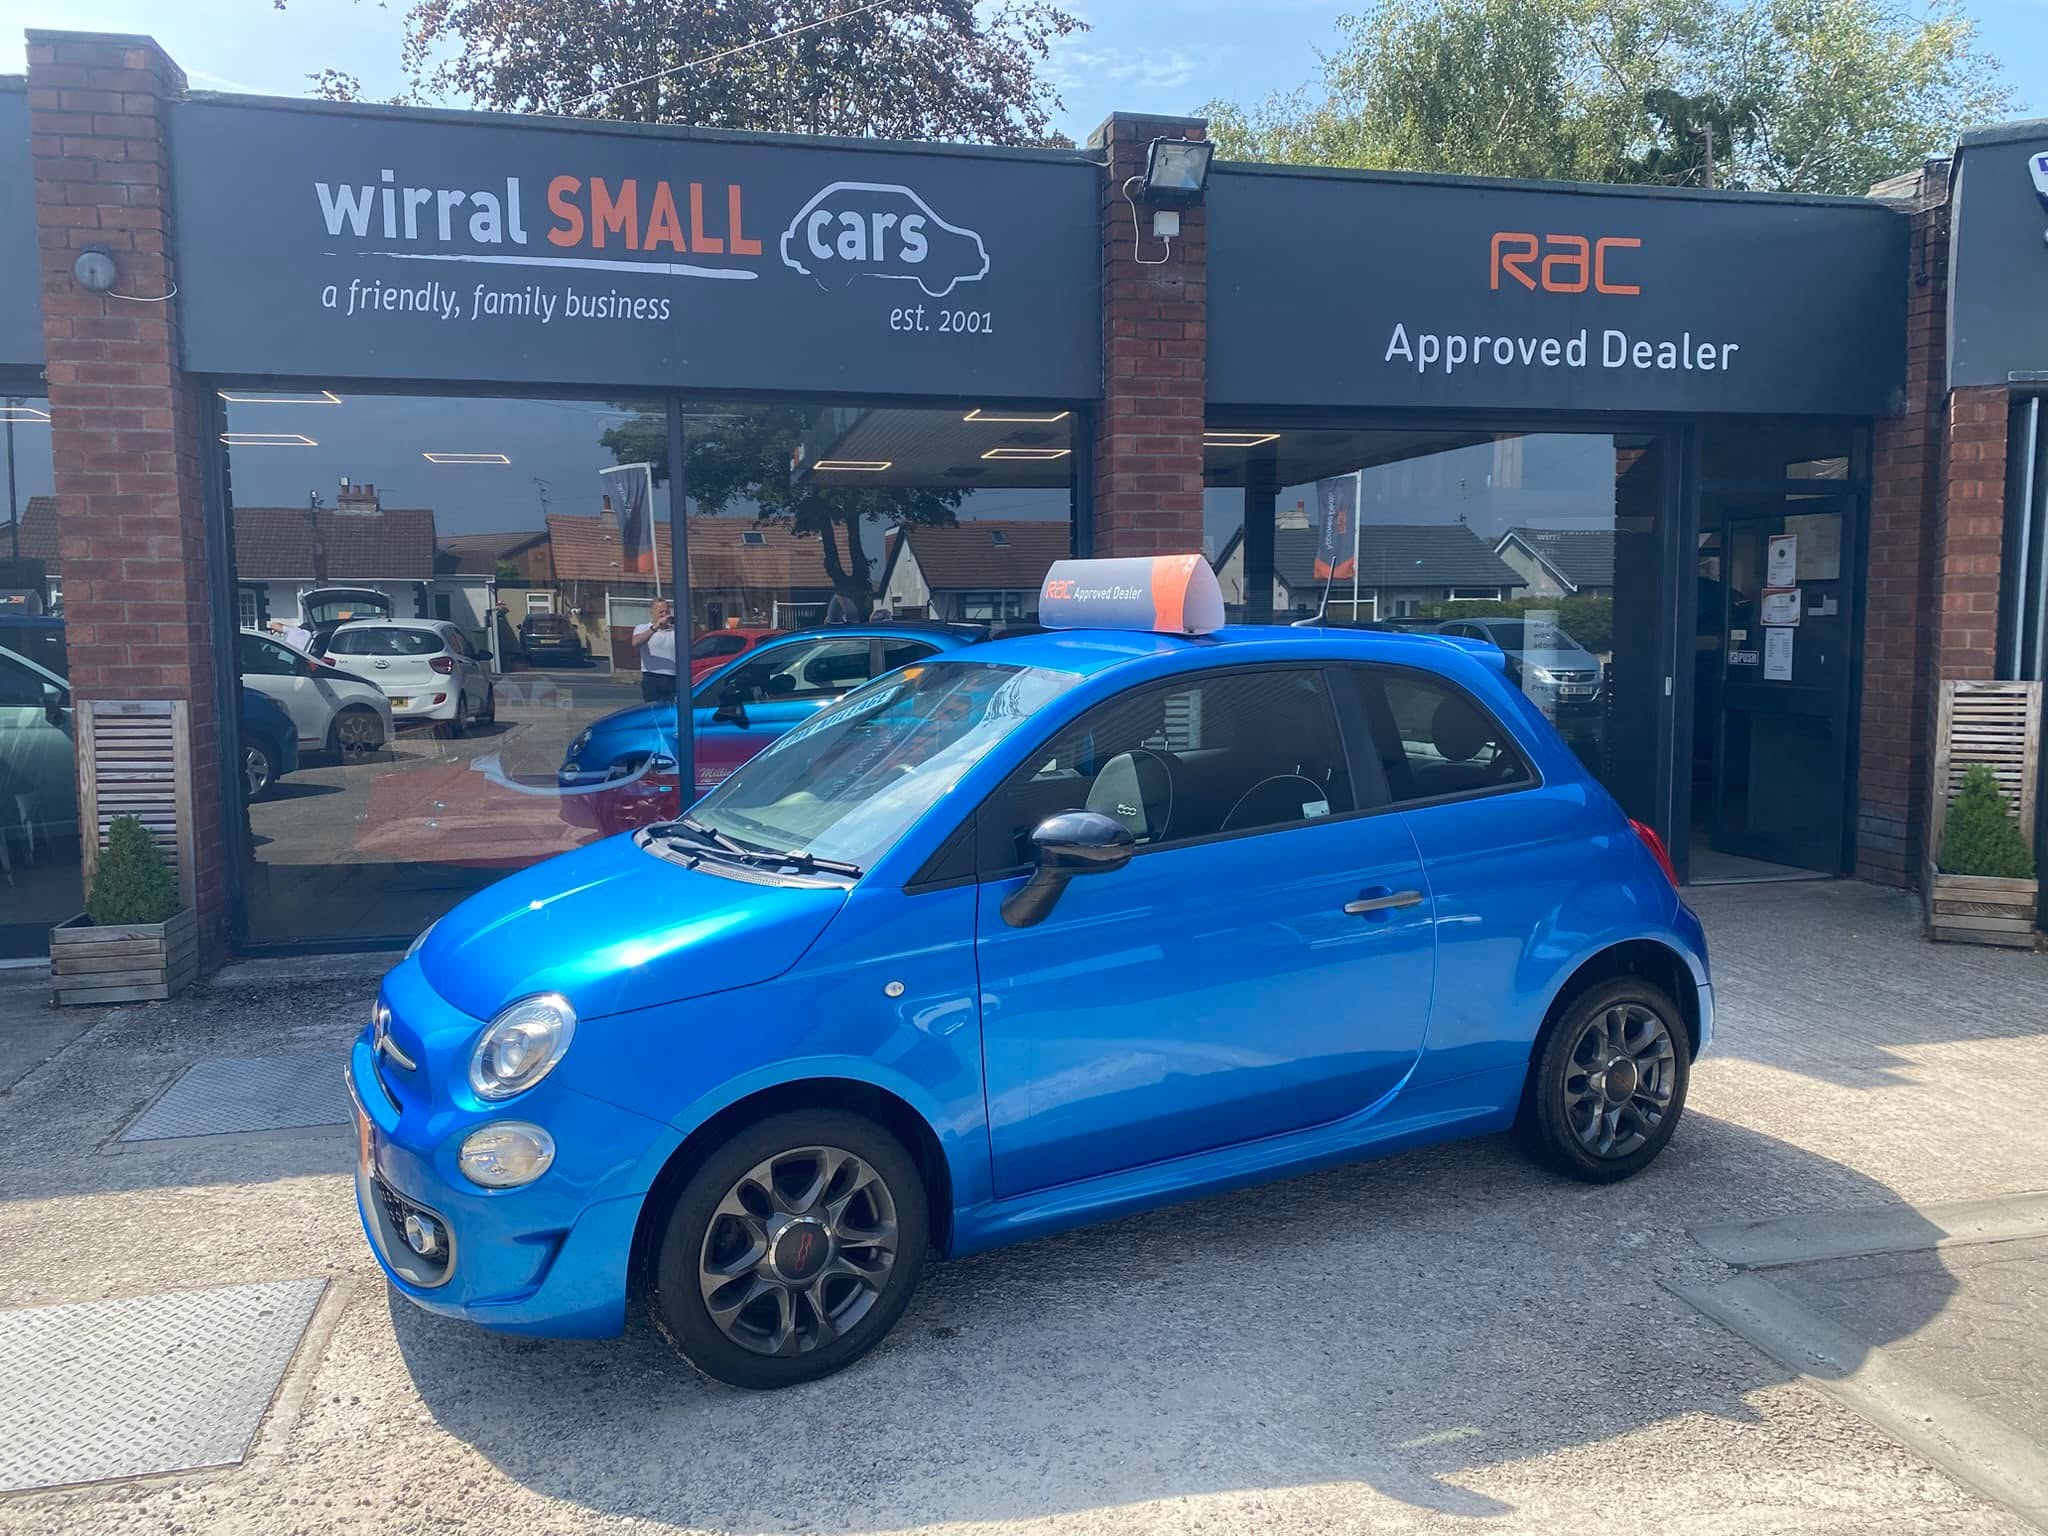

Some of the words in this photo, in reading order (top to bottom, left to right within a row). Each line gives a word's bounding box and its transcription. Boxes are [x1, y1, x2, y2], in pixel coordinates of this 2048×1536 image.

[315, 169, 527, 244] wirral
[547, 175, 761, 255] SMALL
[807, 209, 929, 263] cars
[322, 285, 337, 308] a
[347, 279, 460, 320] friendly,
[471, 284, 557, 323] family
[565, 288, 671, 320] business
[890, 304, 929, 331] est.
[940, 310, 993, 333] 2001
[1385, 322, 1587, 374] Approved
[1602, 330, 1739, 370] Dealer
[1073, 586, 1113, 602] Approved
[1113, 586, 1142, 600] Dealer
